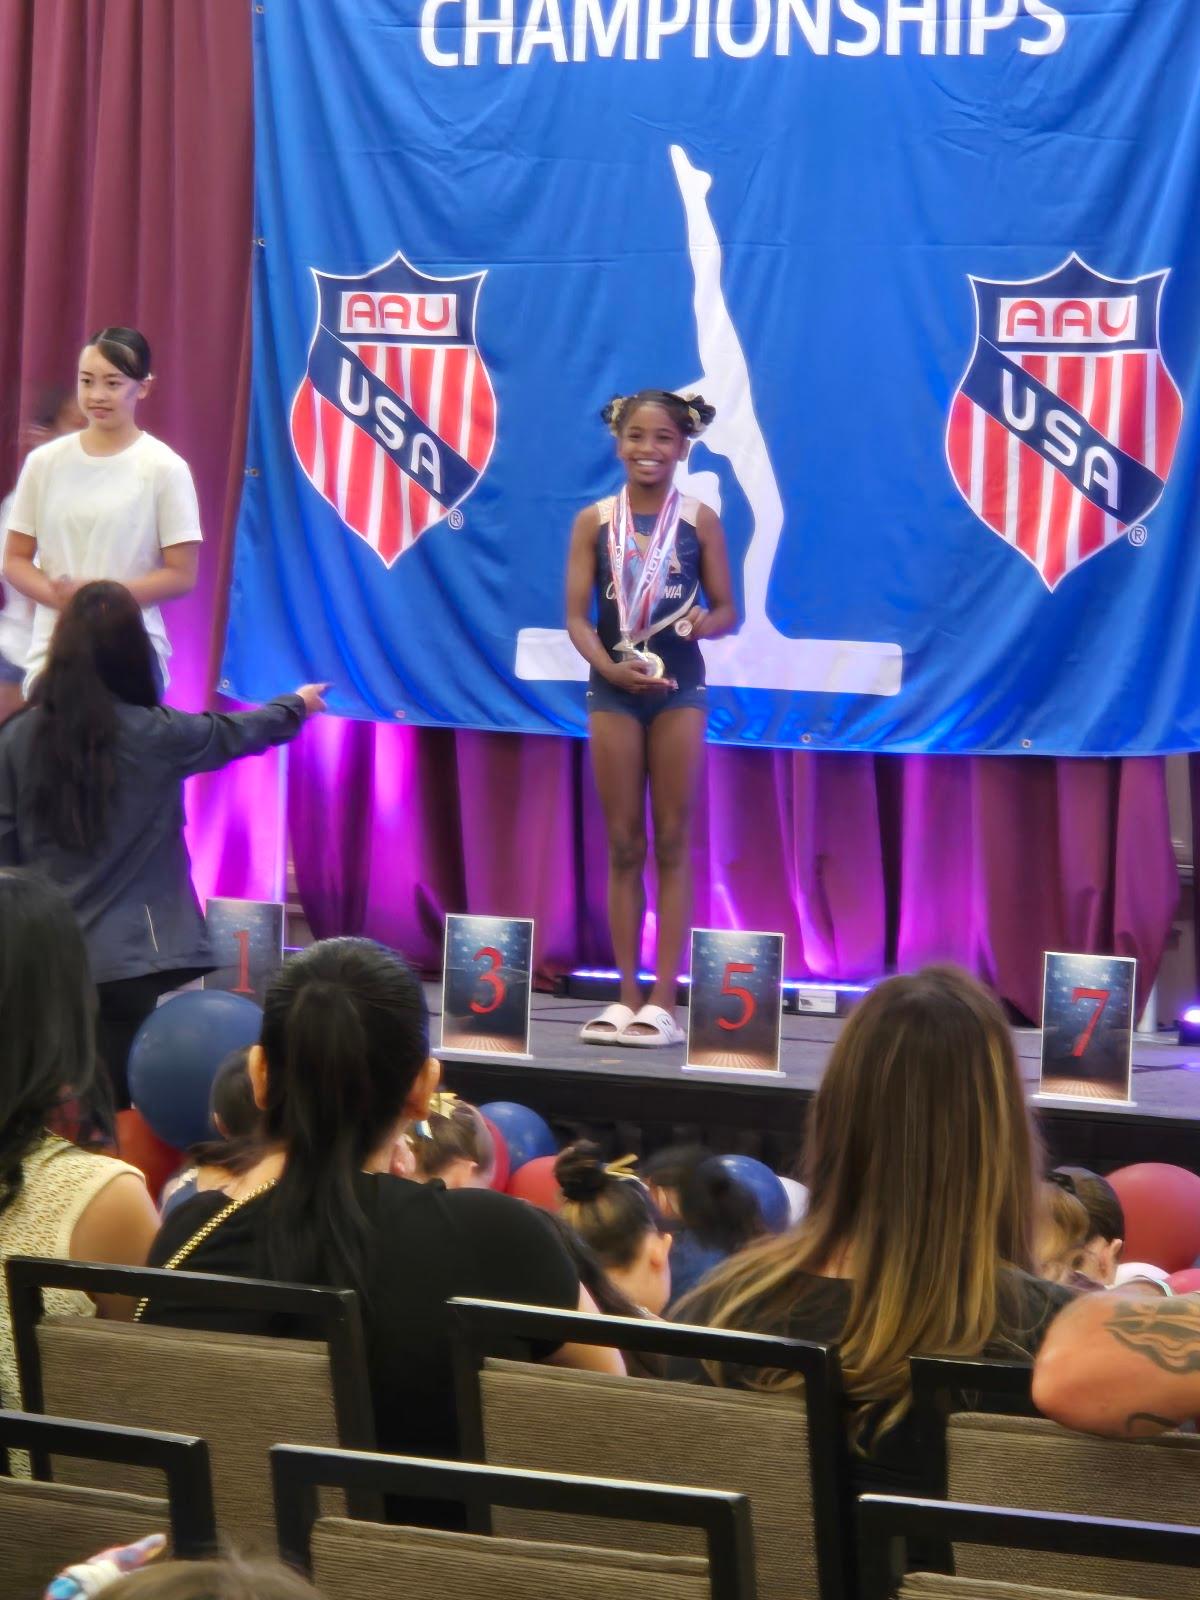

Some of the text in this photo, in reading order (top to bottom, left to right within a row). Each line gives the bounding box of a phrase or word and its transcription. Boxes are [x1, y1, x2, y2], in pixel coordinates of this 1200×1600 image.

[420, 0, 1066, 66] CHAMPIONSHIPS
[346, 293, 450, 331] AAU
[1006, 300, 1131, 337] AAU
[339, 357, 441, 494] USA
[1002, 368, 1119, 510] USA
[231, 929, 255, 994] 1
[469, 946, 506, 1014] 3
[716, 962, 757, 1031] 5
[1071, 987, 1111, 1057] 7
